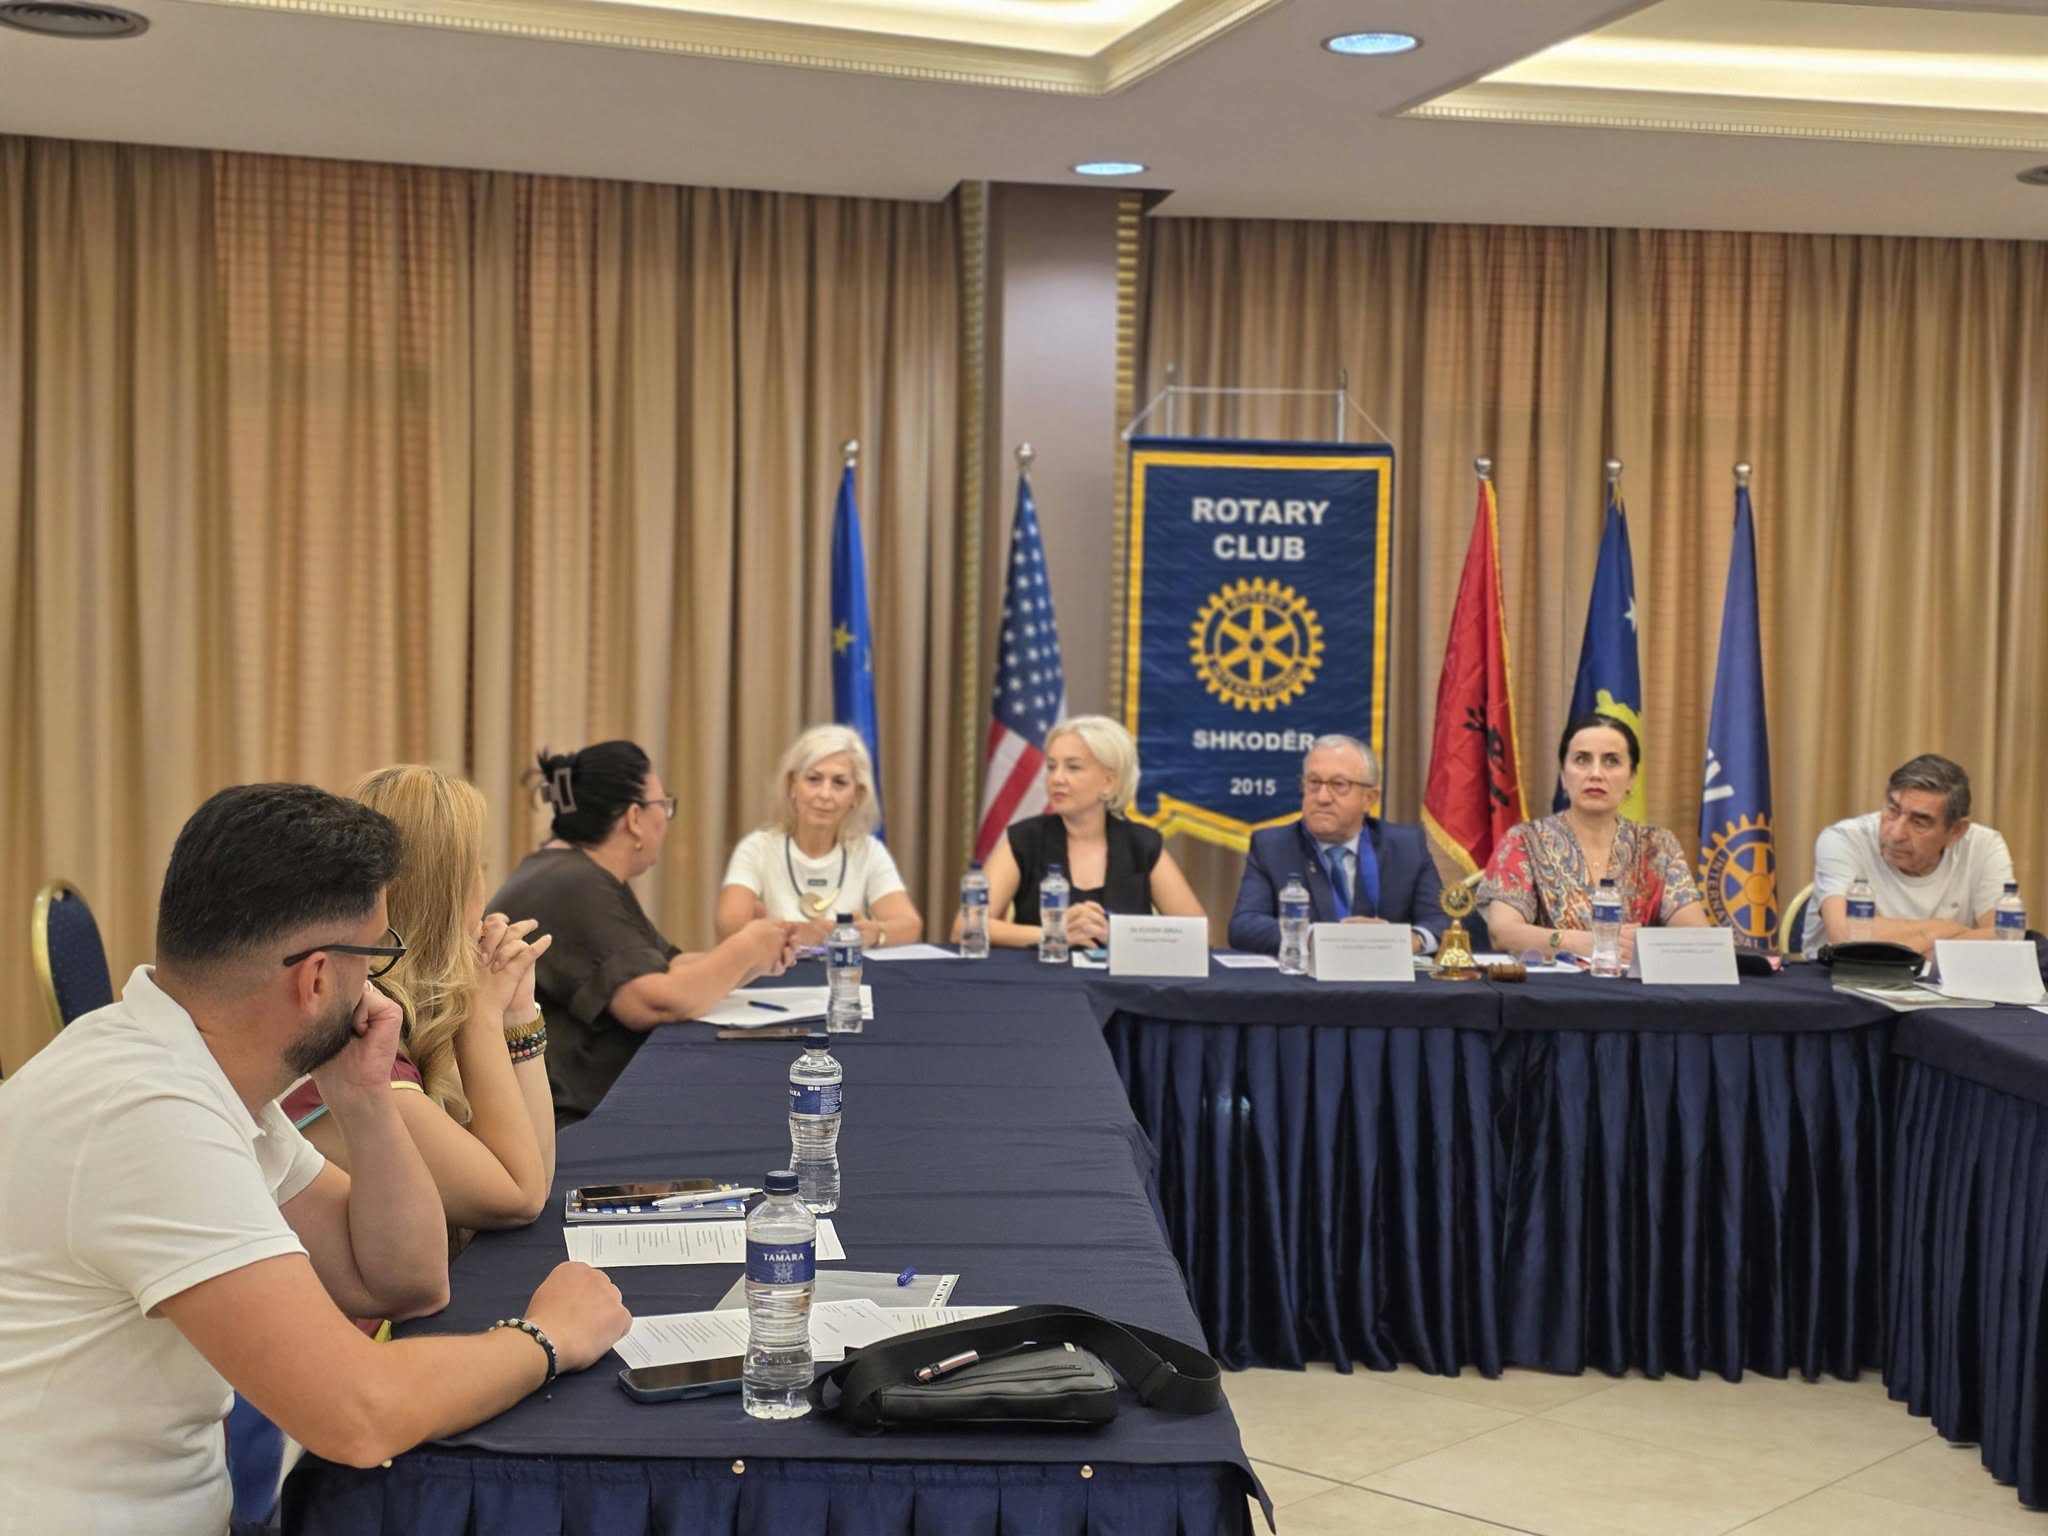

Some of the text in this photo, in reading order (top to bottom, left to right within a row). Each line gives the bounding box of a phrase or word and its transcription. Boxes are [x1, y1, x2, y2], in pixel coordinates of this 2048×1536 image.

[1191, 497, 1331, 525] ROTARY
[1213, 533, 1306, 561] CLUB
[1192, 728, 1316, 752] SHKODËR
[1230, 778, 1277, 796] 2015
[762, 1252, 805, 1262] TAMARA
